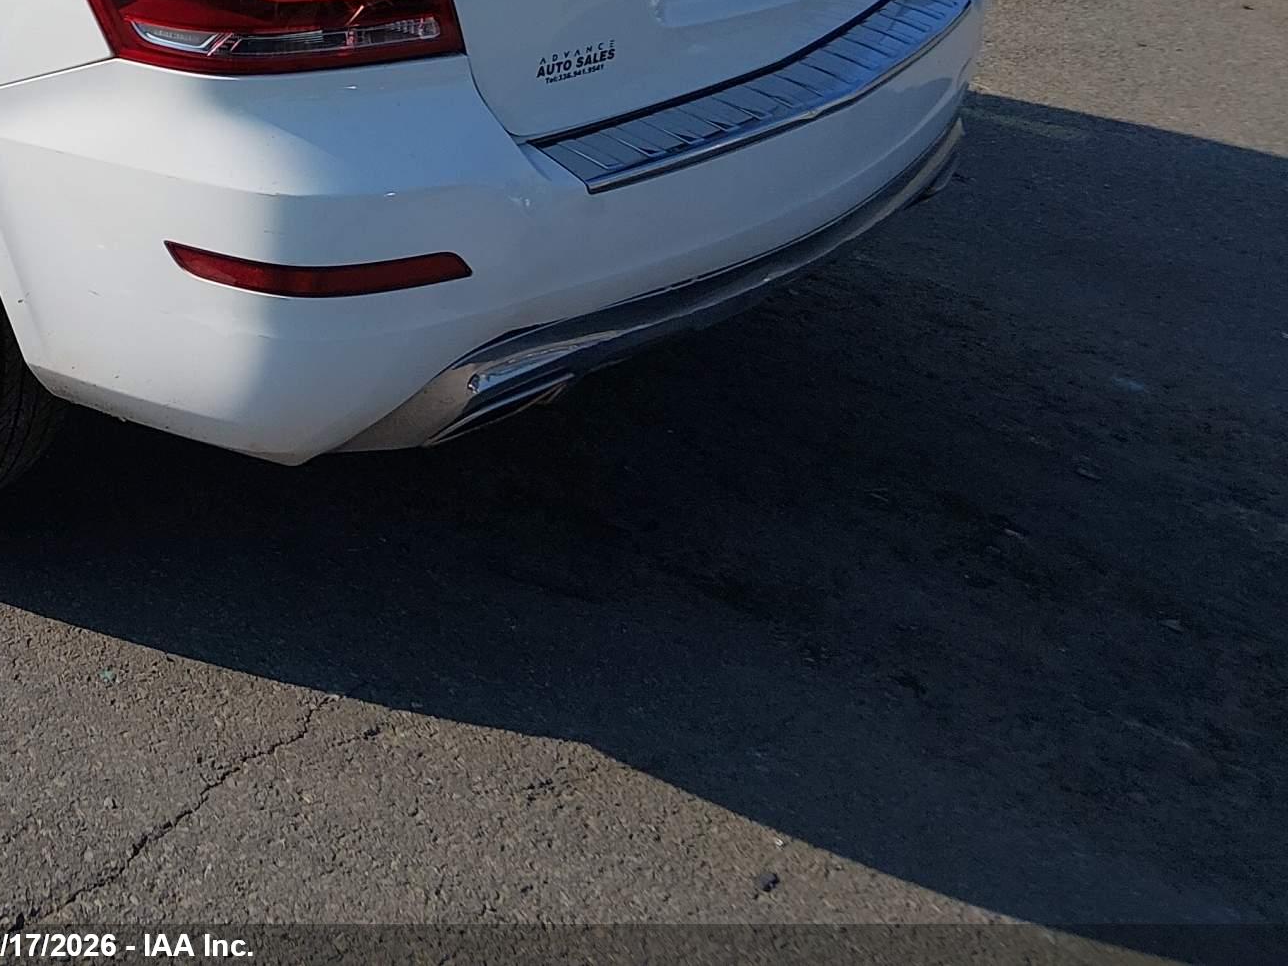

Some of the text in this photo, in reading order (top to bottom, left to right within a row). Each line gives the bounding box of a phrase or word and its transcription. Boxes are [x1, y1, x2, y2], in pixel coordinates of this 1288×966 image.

[536, 48, 616, 78] AUTO SALES
[539, 39, 615, 65] ADVANCE
